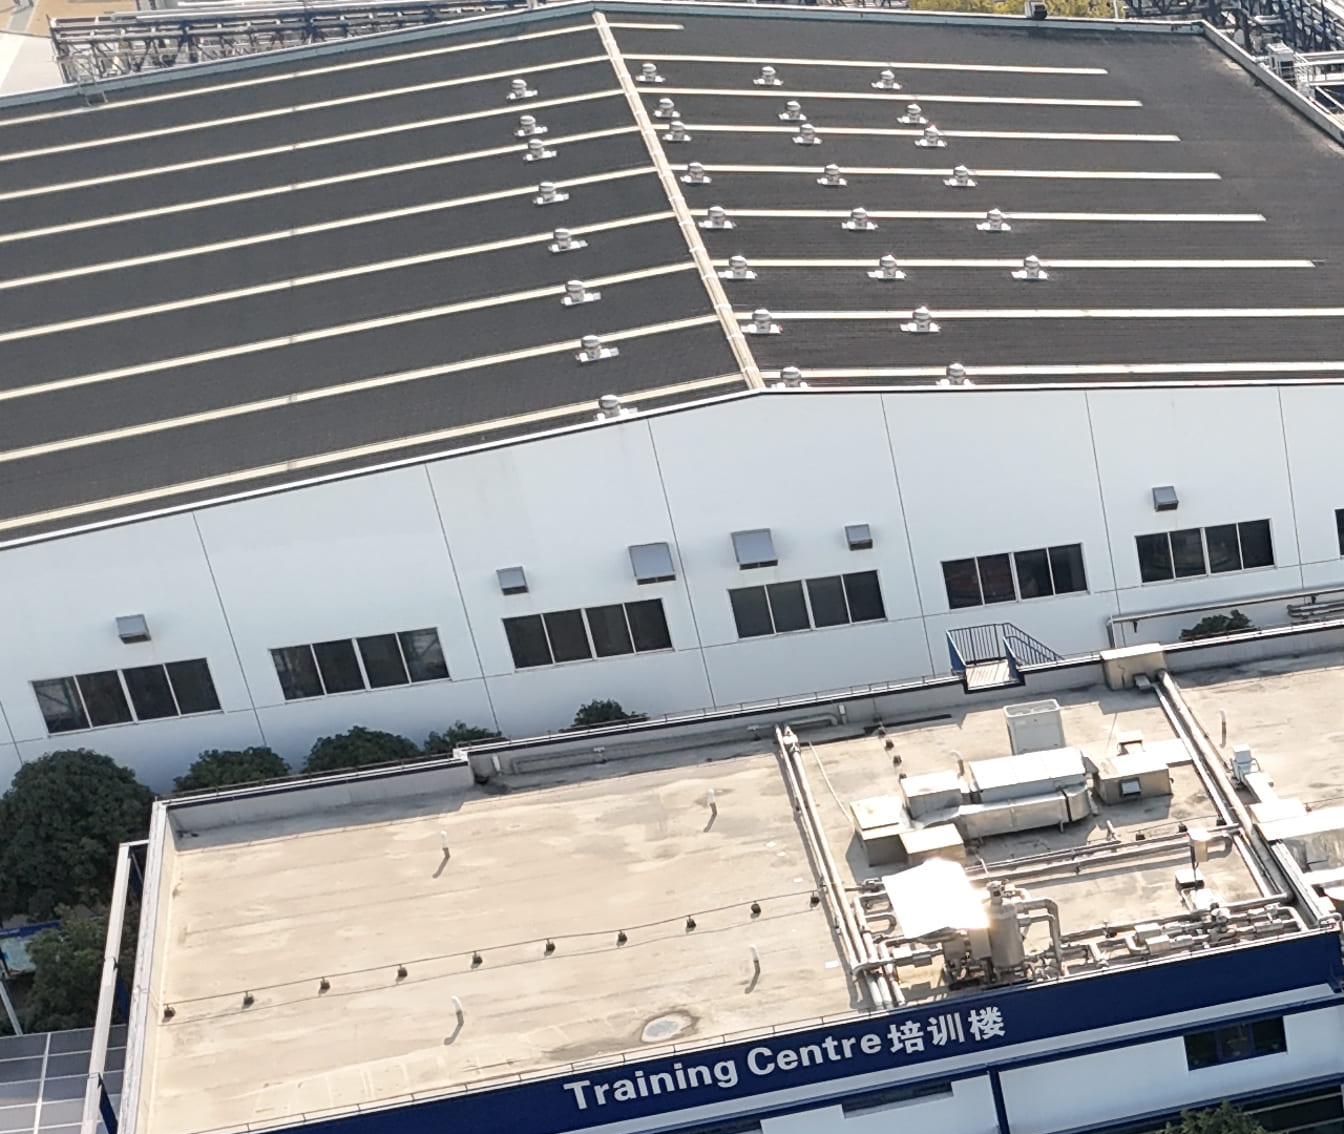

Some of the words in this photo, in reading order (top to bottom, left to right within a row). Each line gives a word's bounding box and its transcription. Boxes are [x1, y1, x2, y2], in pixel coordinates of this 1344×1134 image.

[563, 1058, 739, 1111] Training
[746, 1032, 882, 1076] Centre
[887, 1005, 1006, 1055] 培训楼
